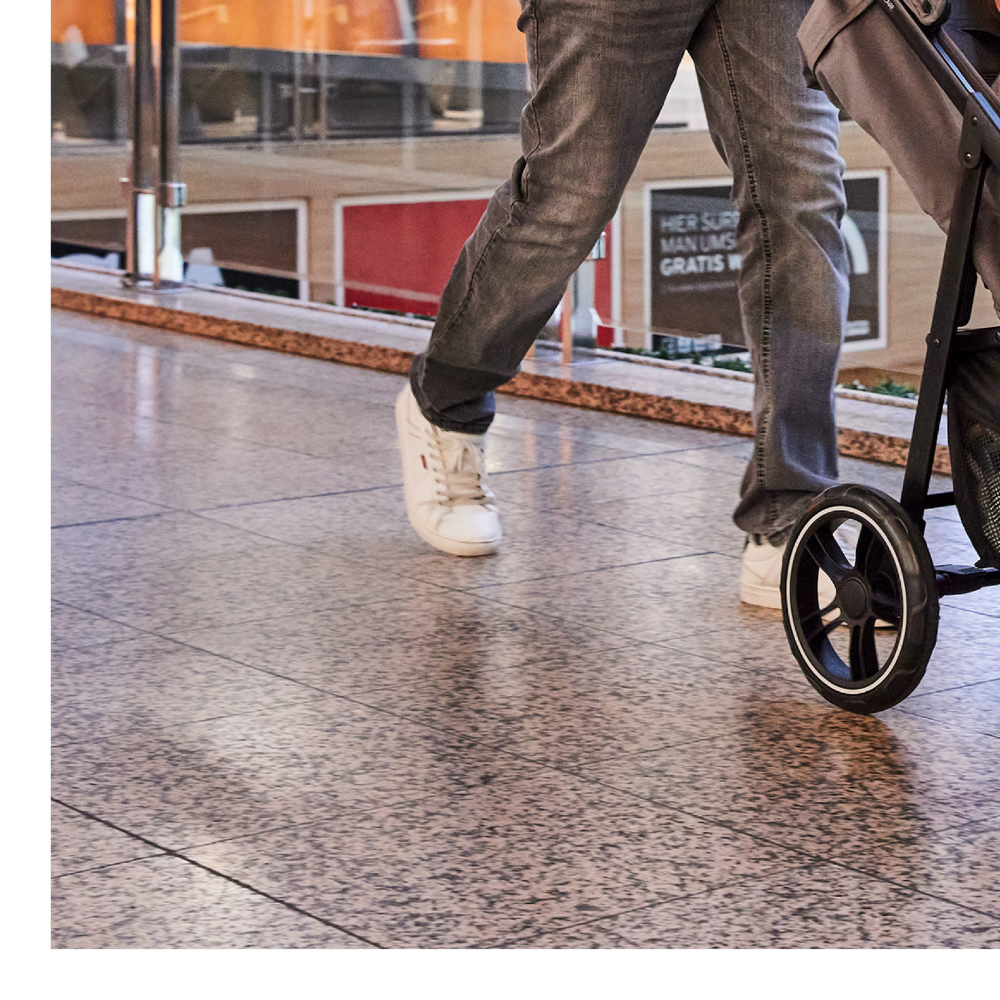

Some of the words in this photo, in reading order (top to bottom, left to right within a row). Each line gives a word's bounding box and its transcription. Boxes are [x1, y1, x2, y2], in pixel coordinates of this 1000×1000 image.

[660, 213, 698, 233] HIER
[661, 236, 697, 253] MAN
[660, 253, 724, 276] GRATIS
